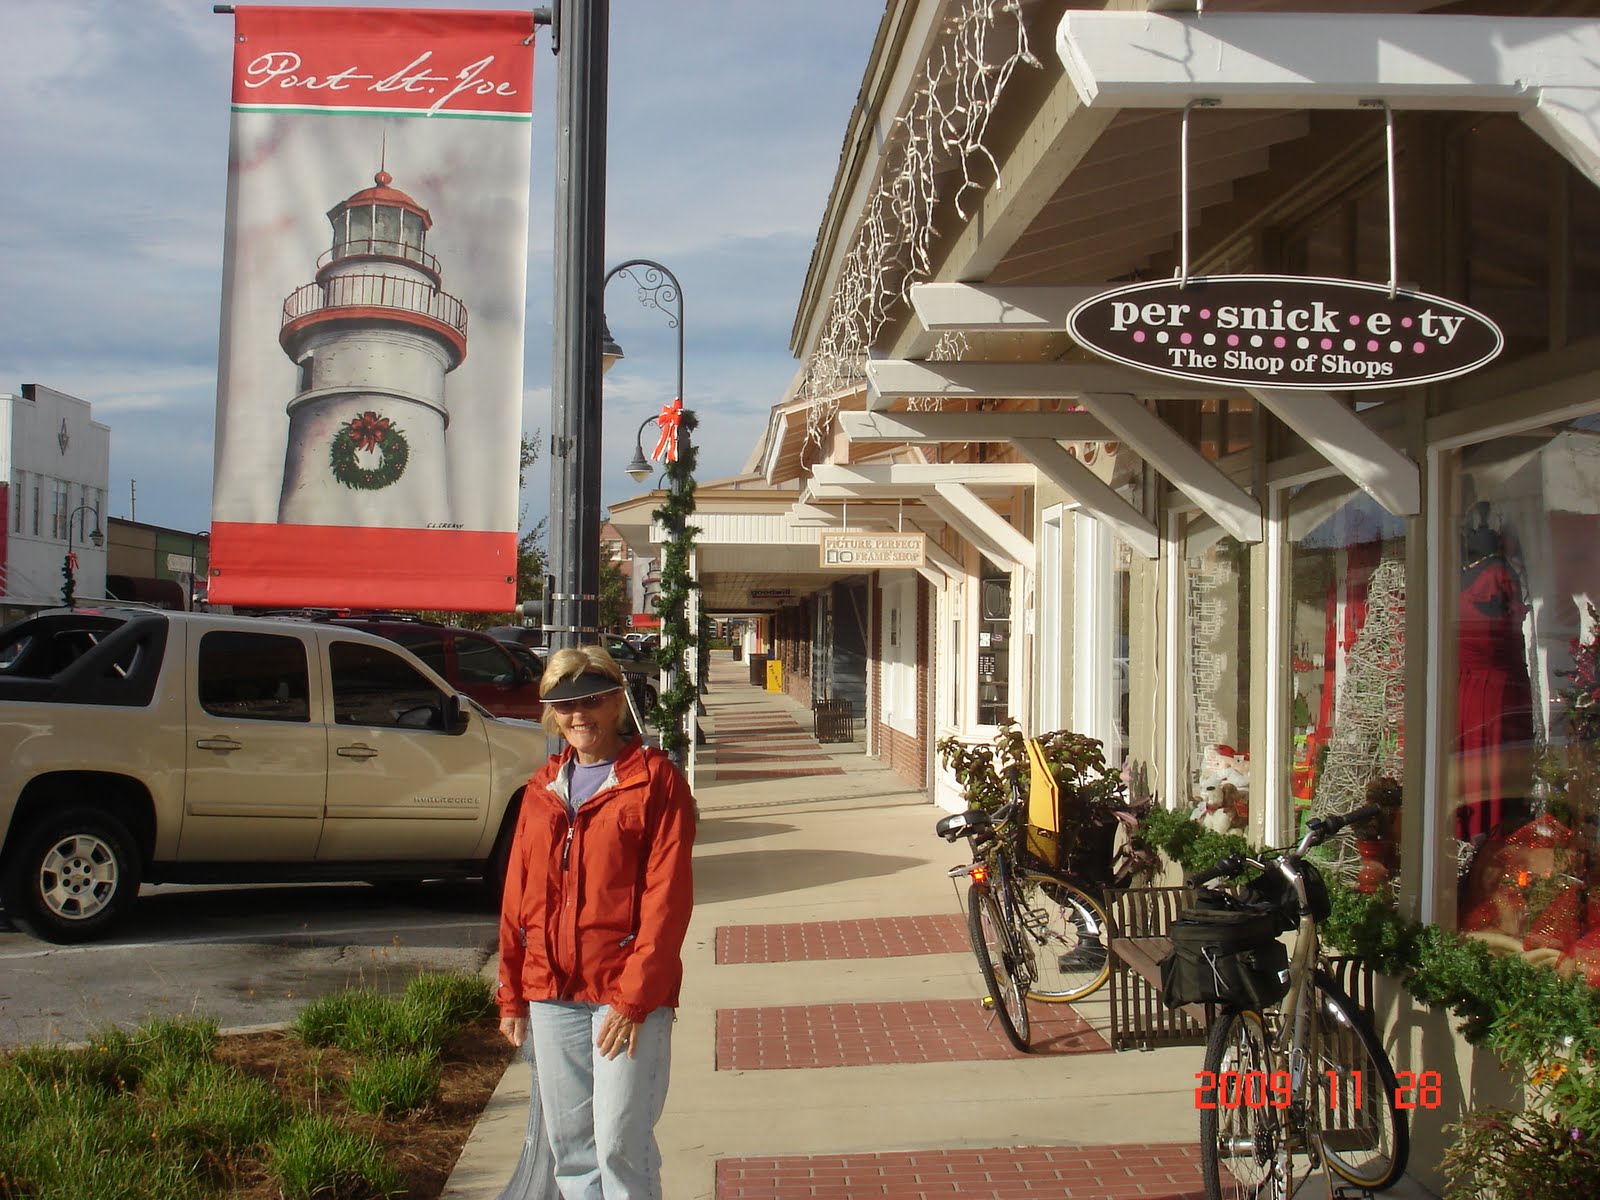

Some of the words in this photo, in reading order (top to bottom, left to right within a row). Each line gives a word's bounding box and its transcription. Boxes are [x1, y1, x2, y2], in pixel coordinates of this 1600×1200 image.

[244, 52, 373, 89] Port
[368, 51, 449, 93] St.
[426, 56, 518, 117] Joe
[1168, 348, 1217, 368] The
[1224, 350, 1284, 375] Shop
[1290, 353, 1318, 372] of
[1321, 354, 1394, 378] Shops
[825, 540, 872, 549] PICTURE
[875, 540, 922, 549] PERFECT
[855, 551, 890, 561] FRAME
[892, 551, 919, 561] SHOP
